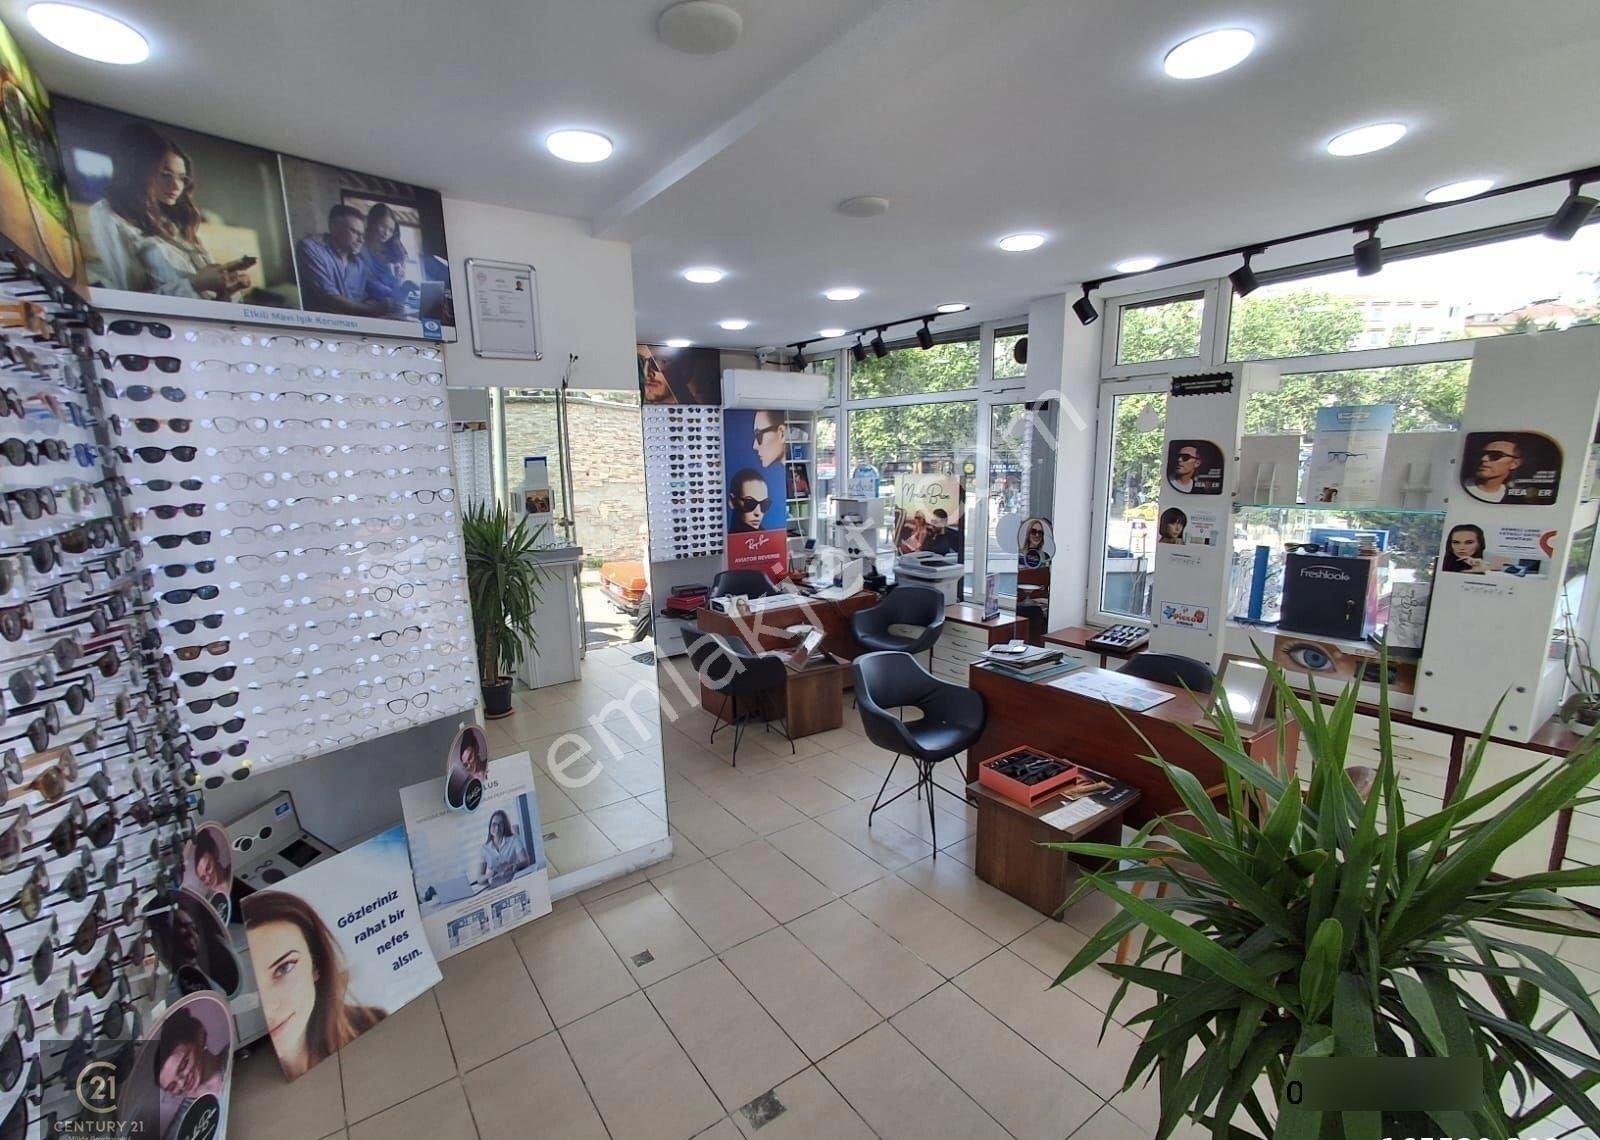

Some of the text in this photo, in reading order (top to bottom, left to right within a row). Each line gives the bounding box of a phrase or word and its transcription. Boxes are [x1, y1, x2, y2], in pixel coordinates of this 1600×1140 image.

[271, 311, 294, 322] Mavi
[337, 890, 399, 928] Gözleriniz
[354, 909, 405, 944] rahat bir
[376, 930, 410, 955] nefes
[392, 948, 423, 971] alsın.
